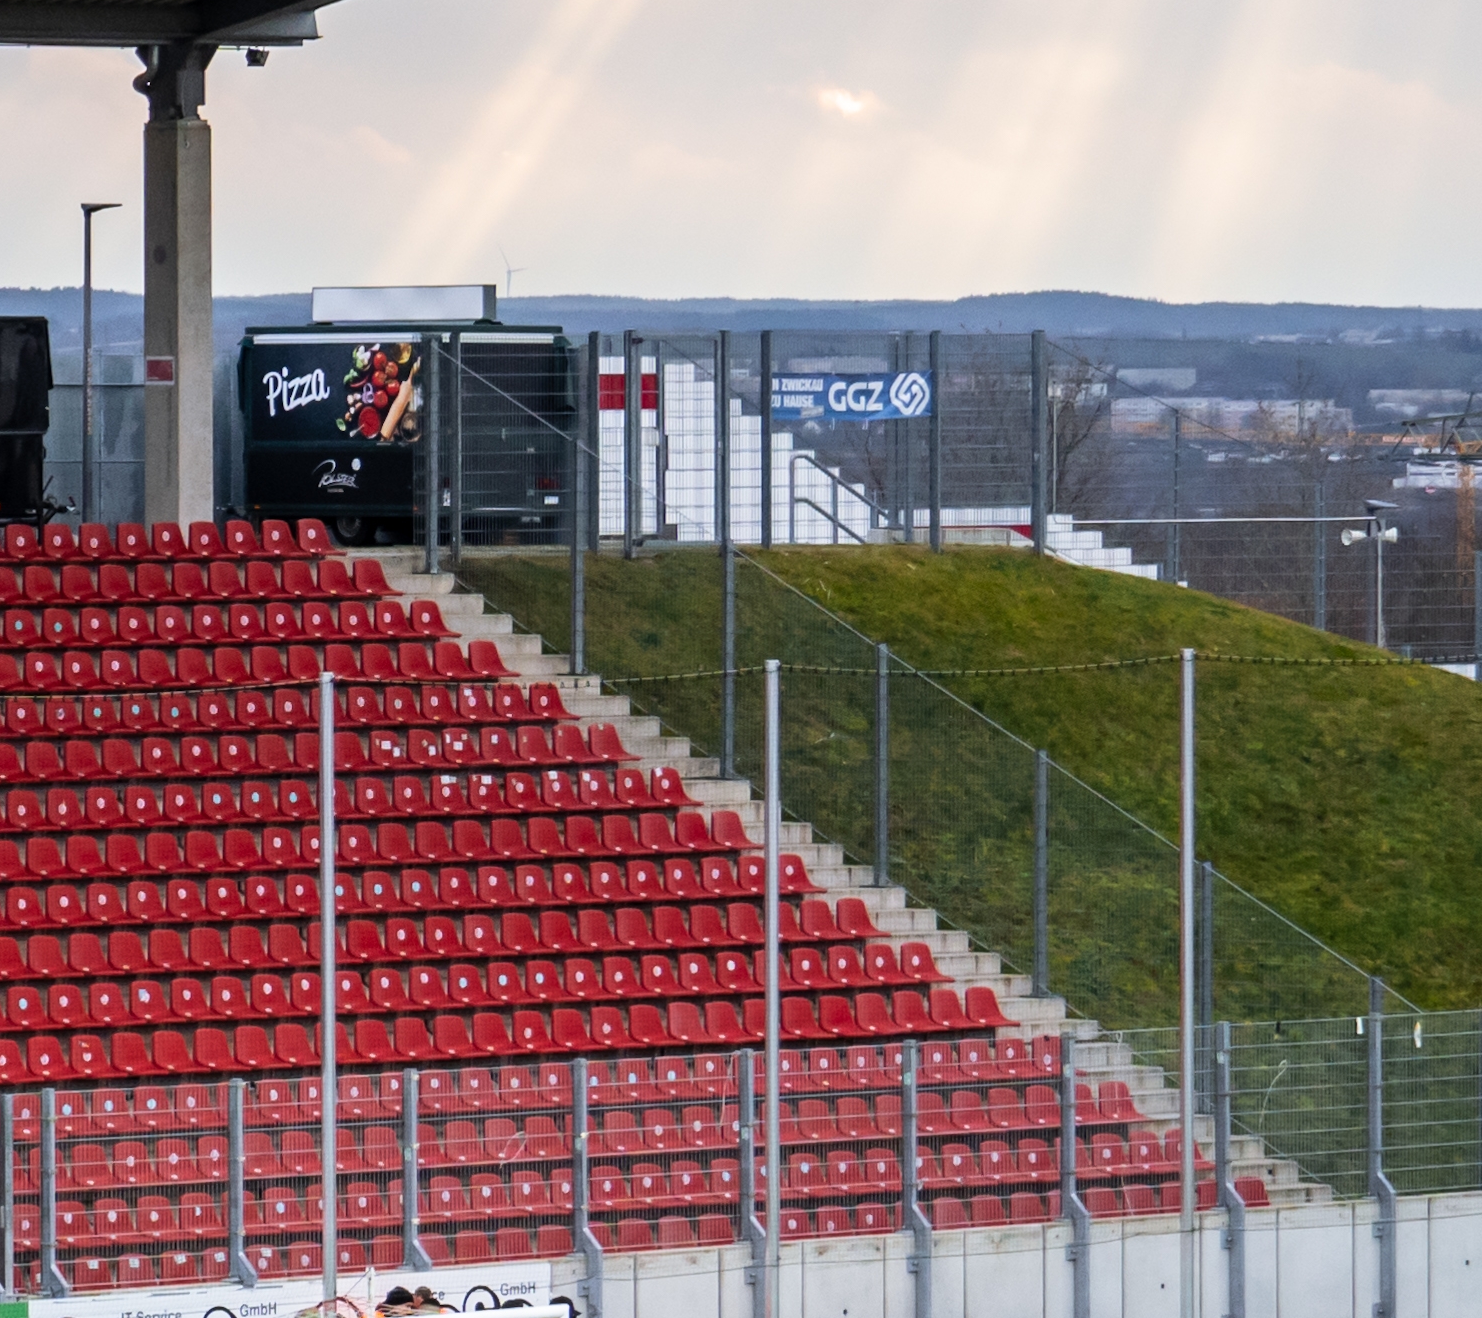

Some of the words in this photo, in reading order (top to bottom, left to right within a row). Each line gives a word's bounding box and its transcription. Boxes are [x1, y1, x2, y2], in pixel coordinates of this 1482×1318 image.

[262, 366, 331, 417] Pizza
[781, 378, 824, 392] ZWICKAU
[783, 394, 815, 408] HAUSE
[828, 380, 884, 412] GGZ
[499, 1282, 537, 1296] GmbH
[239, 1302, 278, 1317] GmbH
